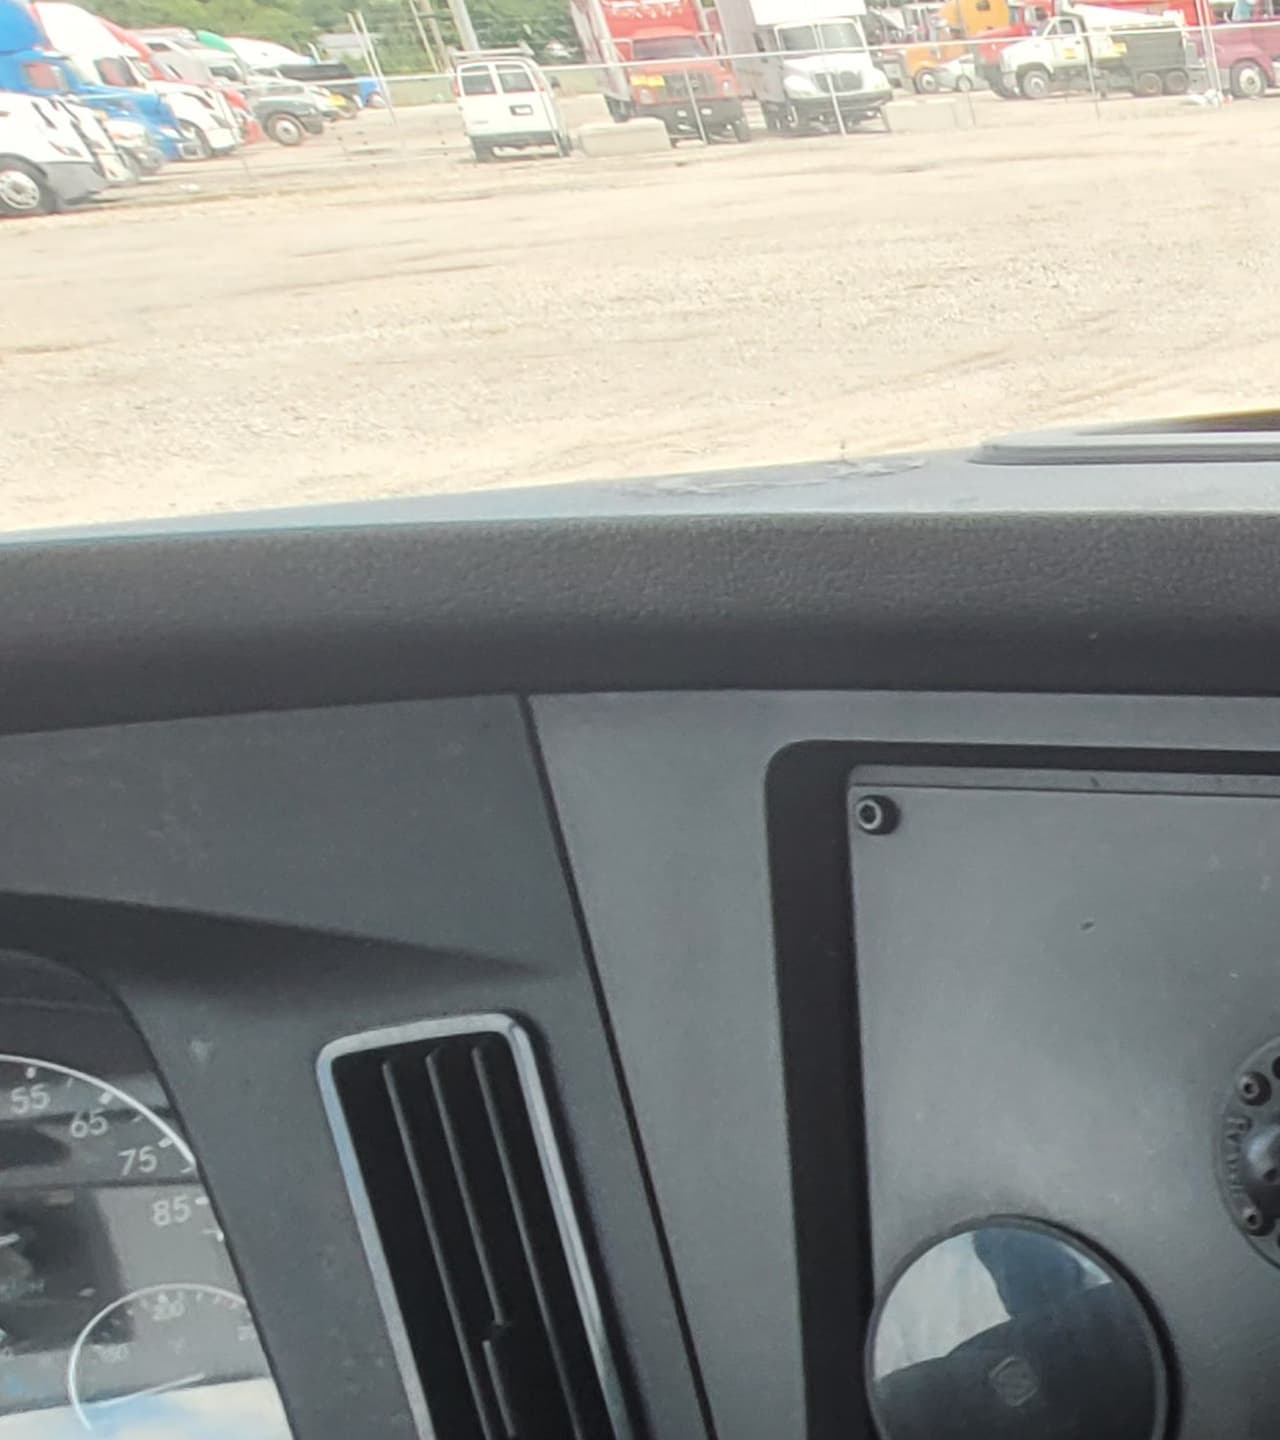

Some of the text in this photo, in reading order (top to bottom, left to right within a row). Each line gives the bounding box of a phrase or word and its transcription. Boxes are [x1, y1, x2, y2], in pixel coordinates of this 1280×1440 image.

[10, 1083, 50, 1114] 55
[70, 1109, 109, 1138] 65
[118, 1146, 158, 1176] 75
[153, 1195, 191, 1227] 85
